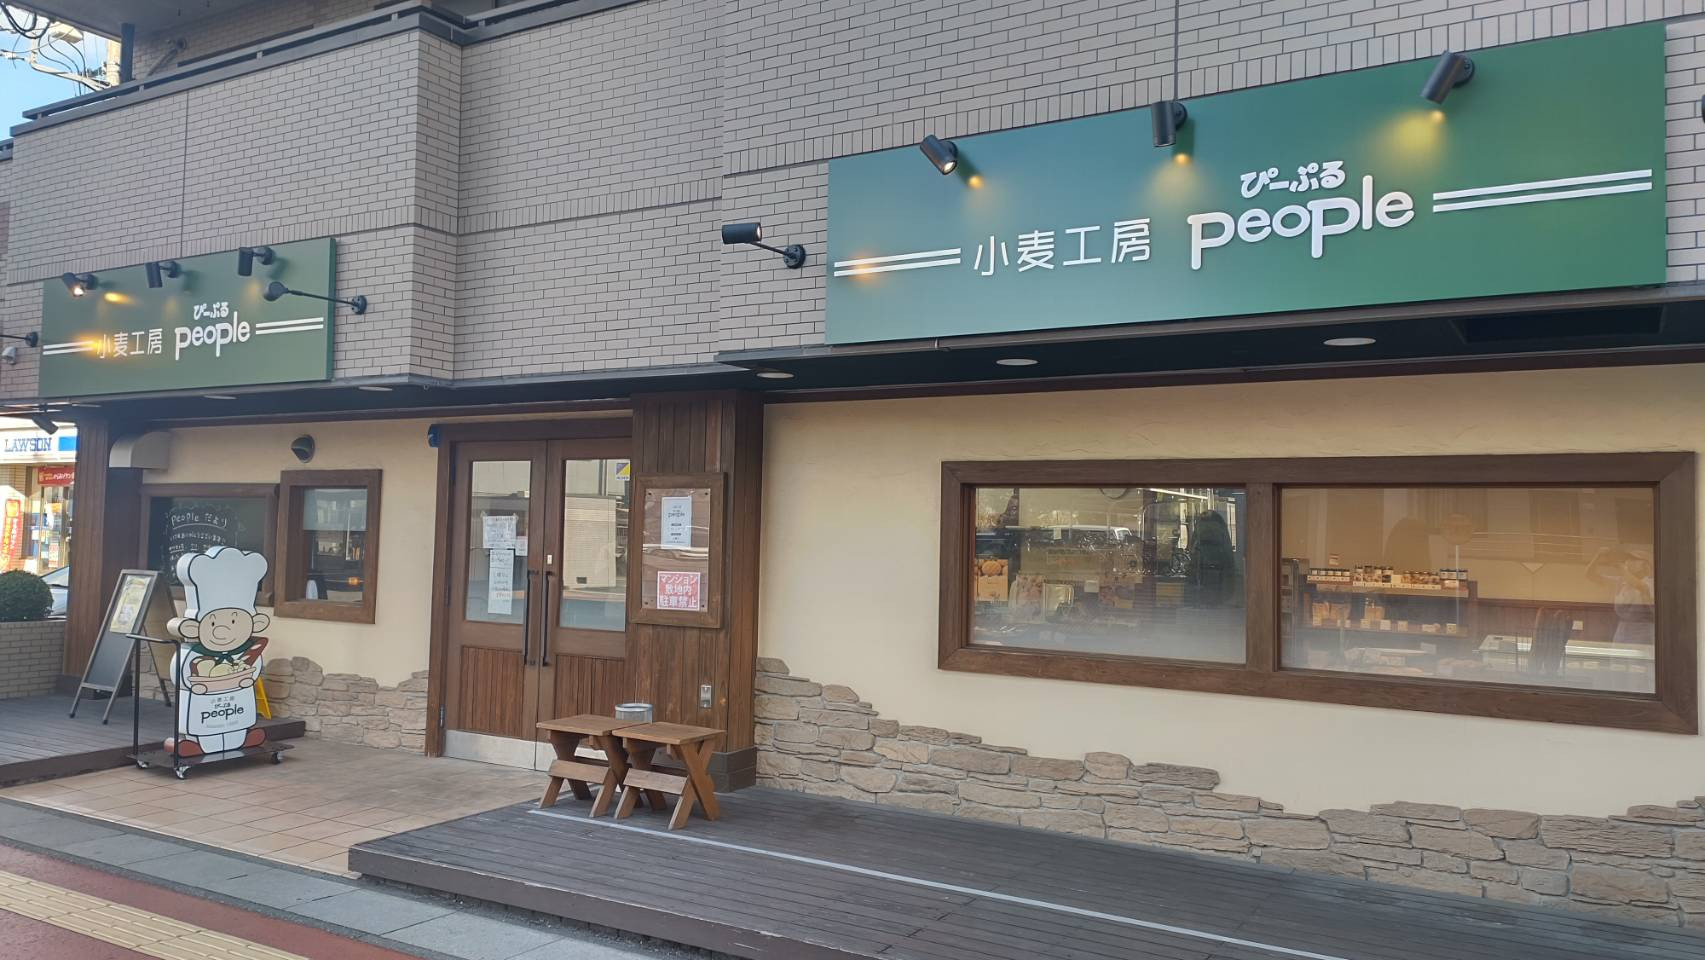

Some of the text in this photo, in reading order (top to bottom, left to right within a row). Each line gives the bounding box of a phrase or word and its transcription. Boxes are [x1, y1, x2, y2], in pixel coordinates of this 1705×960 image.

[1240, 160, 1346, 199] ぴーぷる
[973, 174, 1415, 277] 小麦工房 people
[193, 302, 229, 320] ぴーぷる
[96, 311, 251, 360] 小麦工房 people
[4, 437, 52, 452] LAWSON
[659, 574, 698, 584] マンション
[665, 584, 692, 595] 敷地内
[659, 595, 697, 608] 駐車禁止
[200, 703, 245, 724] people
